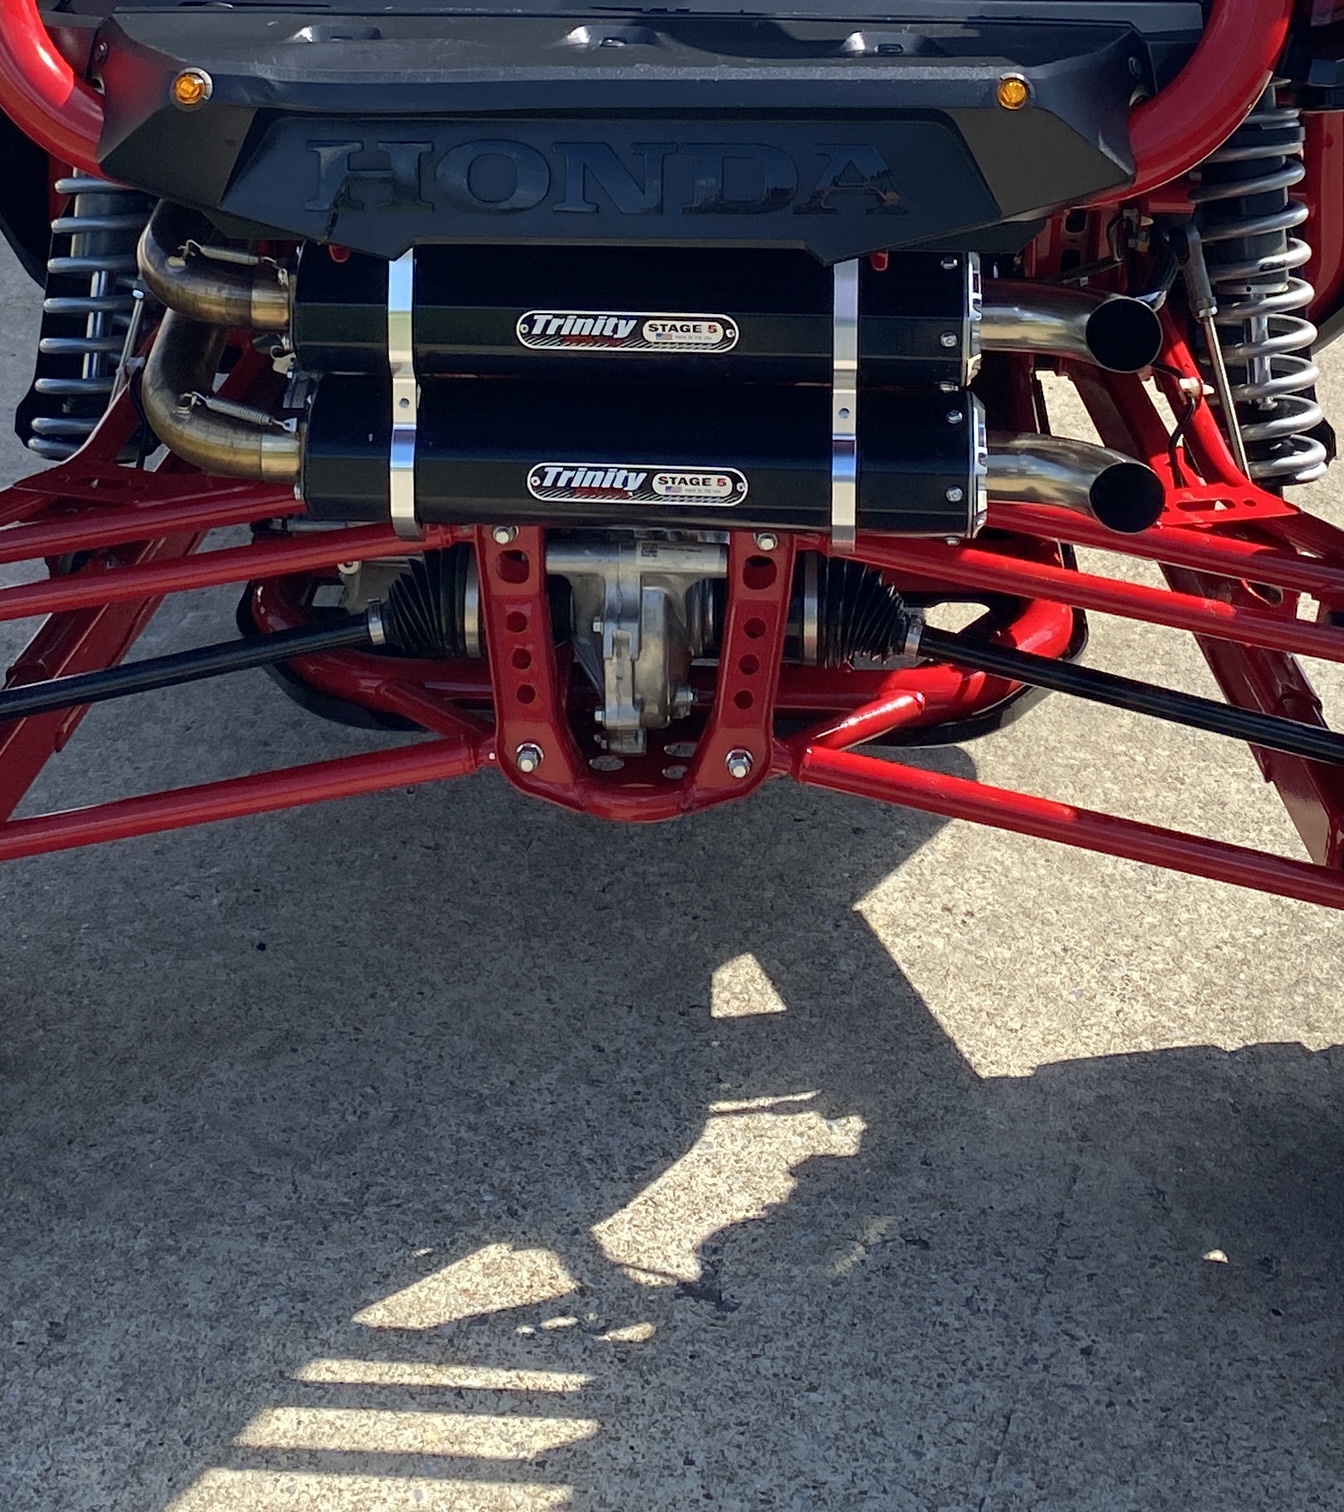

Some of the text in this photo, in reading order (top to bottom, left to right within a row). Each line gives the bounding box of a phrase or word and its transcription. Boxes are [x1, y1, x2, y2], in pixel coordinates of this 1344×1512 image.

[305, 140, 910, 216] HONDA
[531, 315, 638, 338] Trinity
[648, 323, 718, 334] STAGE 5
[542, 467, 647, 491] Trinity
[658, 476, 727, 487] STAGE 5
